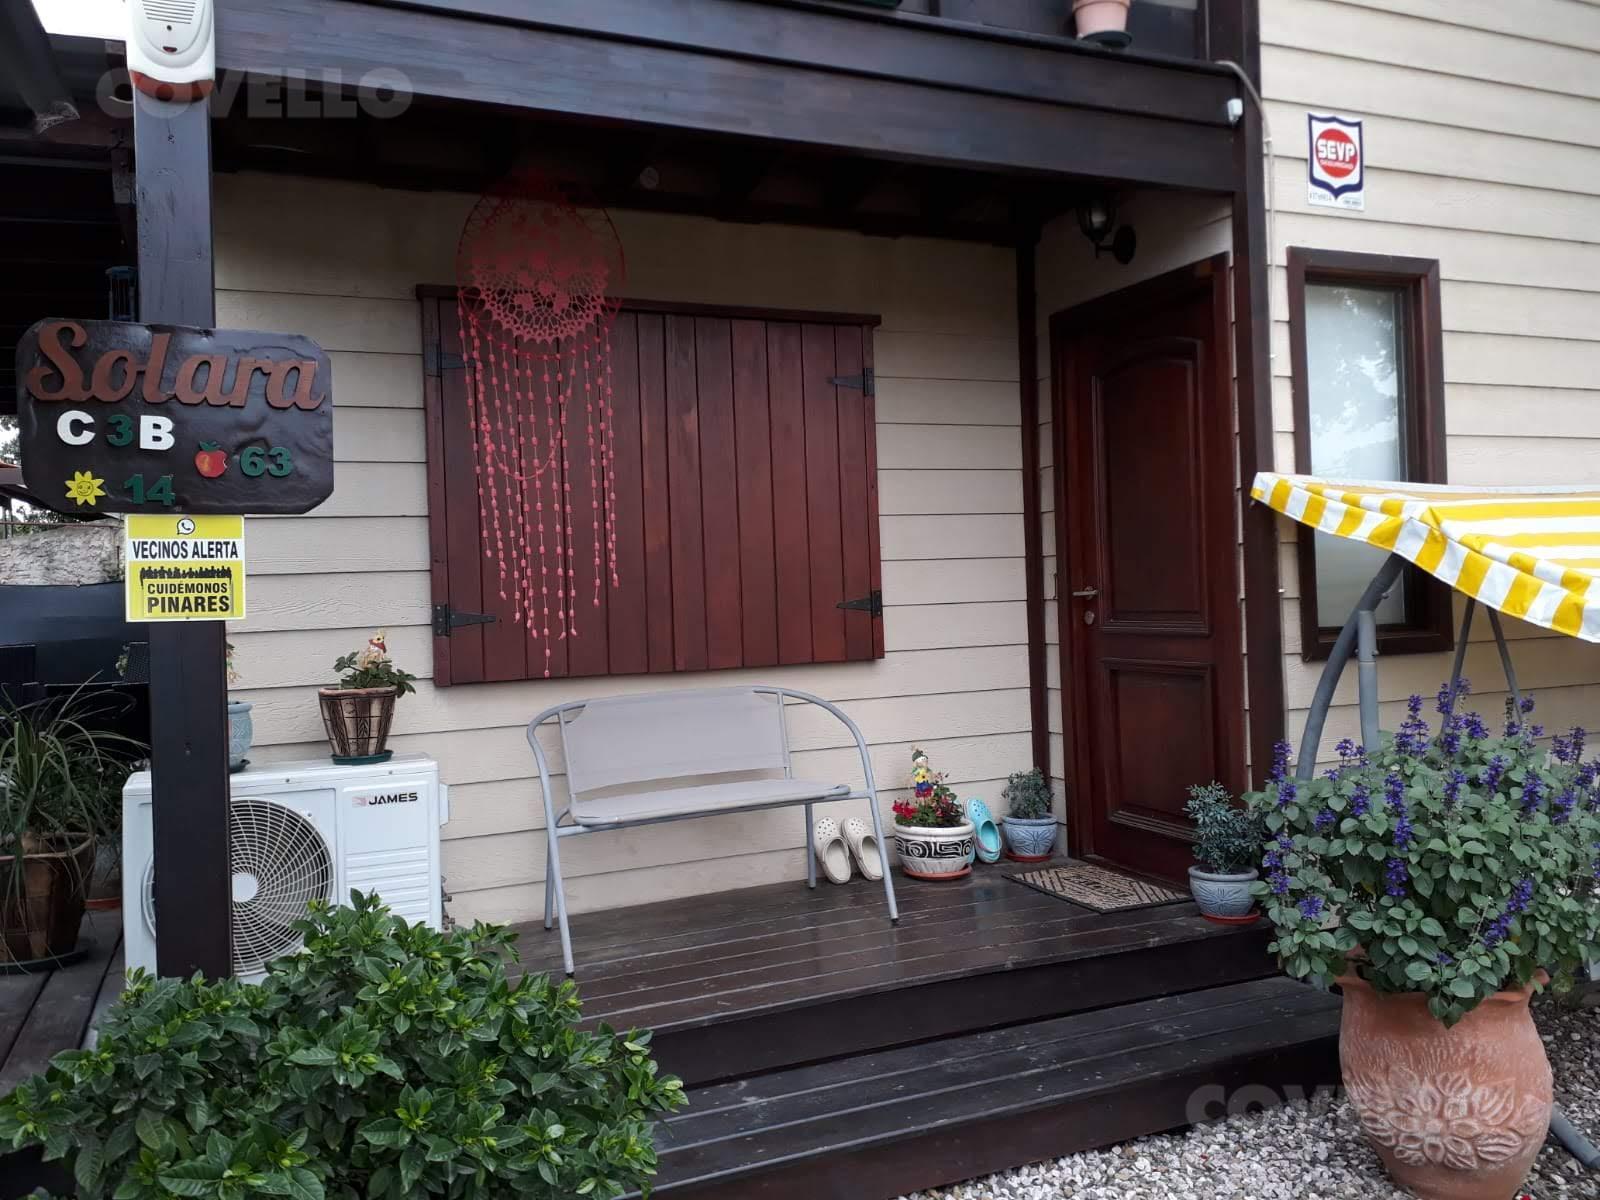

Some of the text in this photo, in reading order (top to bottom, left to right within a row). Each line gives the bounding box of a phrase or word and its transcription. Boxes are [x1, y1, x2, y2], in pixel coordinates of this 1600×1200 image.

[1317, 139, 1355, 162] SEVP
[26, 321, 325, 409] Solara
[240, 446, 292, 478] 63
[124, 473, 176, 506] 14
[132, 540, 239, 560] VECINOS ALERTA
[147, 595, 230, 613] PINARES
[368, 792, 418, 805] JAMES
